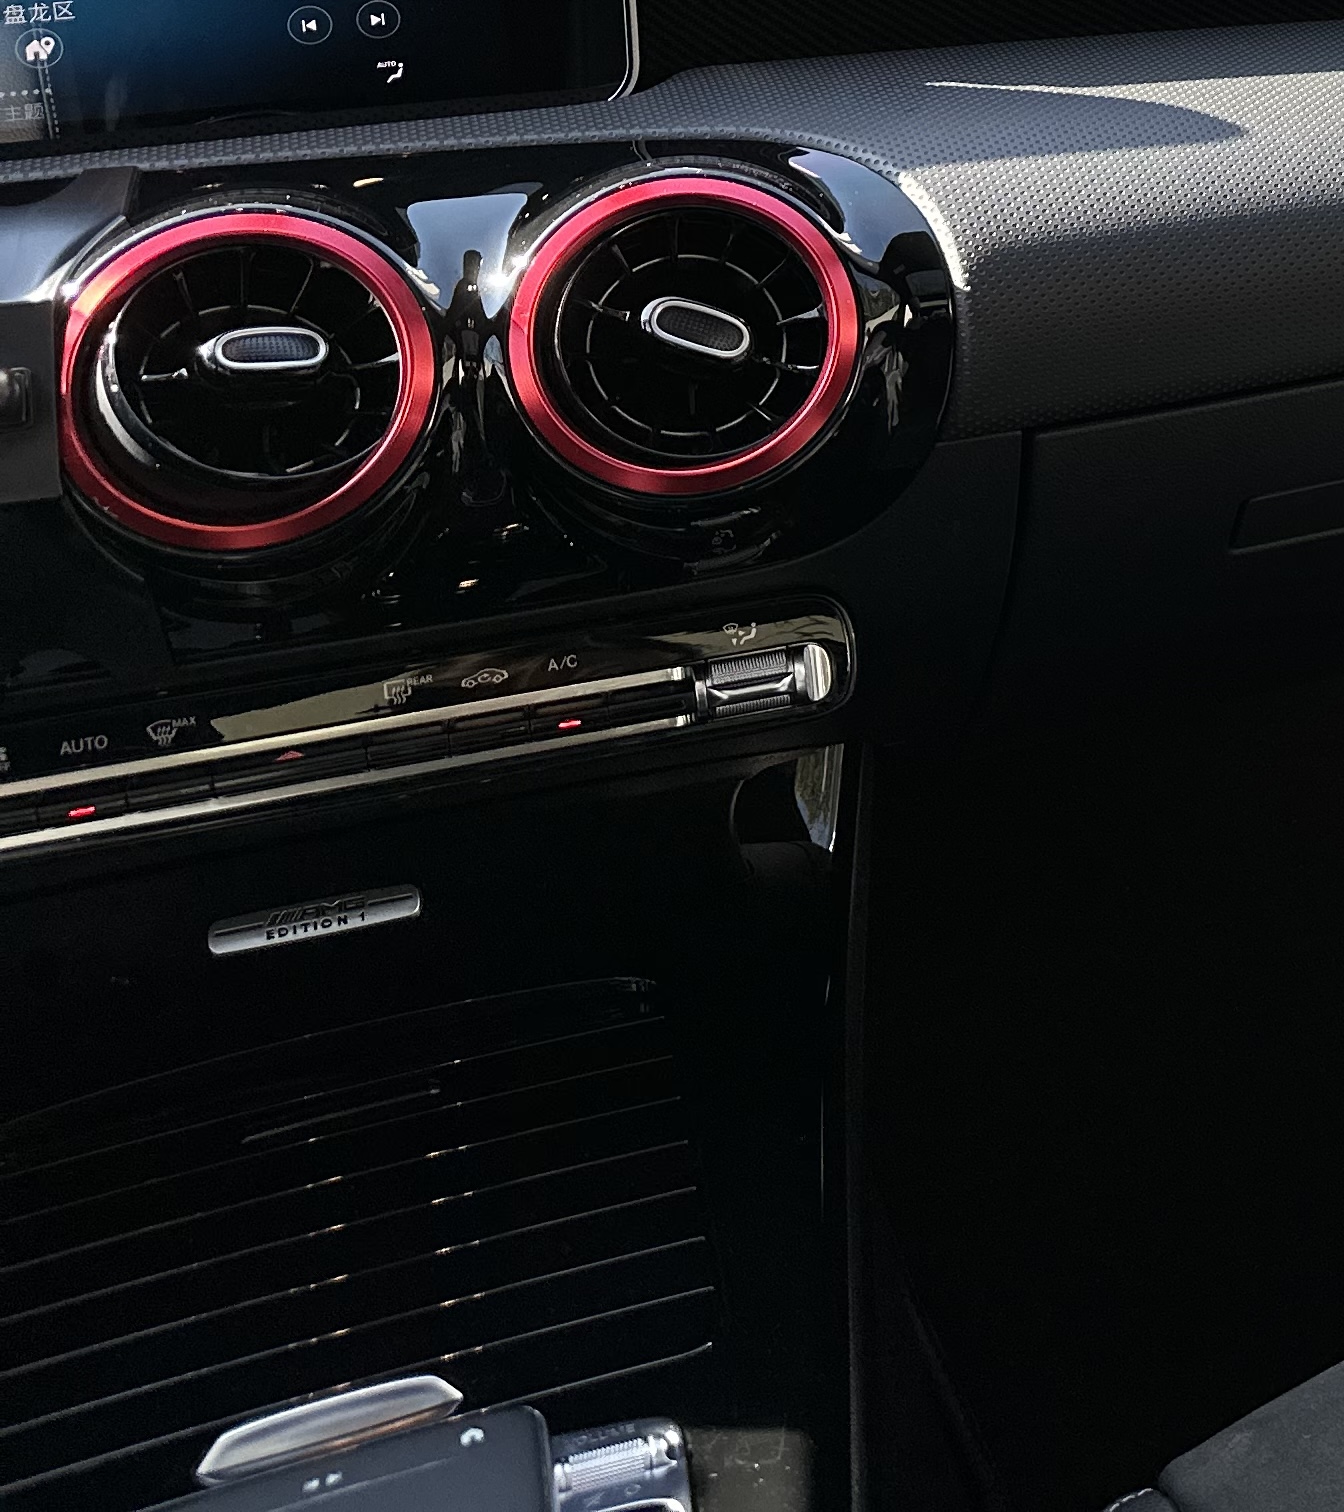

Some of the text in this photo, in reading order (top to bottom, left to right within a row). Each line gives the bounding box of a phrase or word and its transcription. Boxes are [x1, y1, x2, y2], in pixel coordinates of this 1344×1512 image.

[3, 0, 76, 26] 盘龙区
[376, 60, 397, 69] AUTO
[3, 102, 45, 123] 主题
[547, 654, 578, 672] A/C
[406, 674, 433, 686] REAR
[172, 716, 197, 728] MAX
[60, 734, 109, 756] AUTO
[266, 915, 349, 941] EDITION
